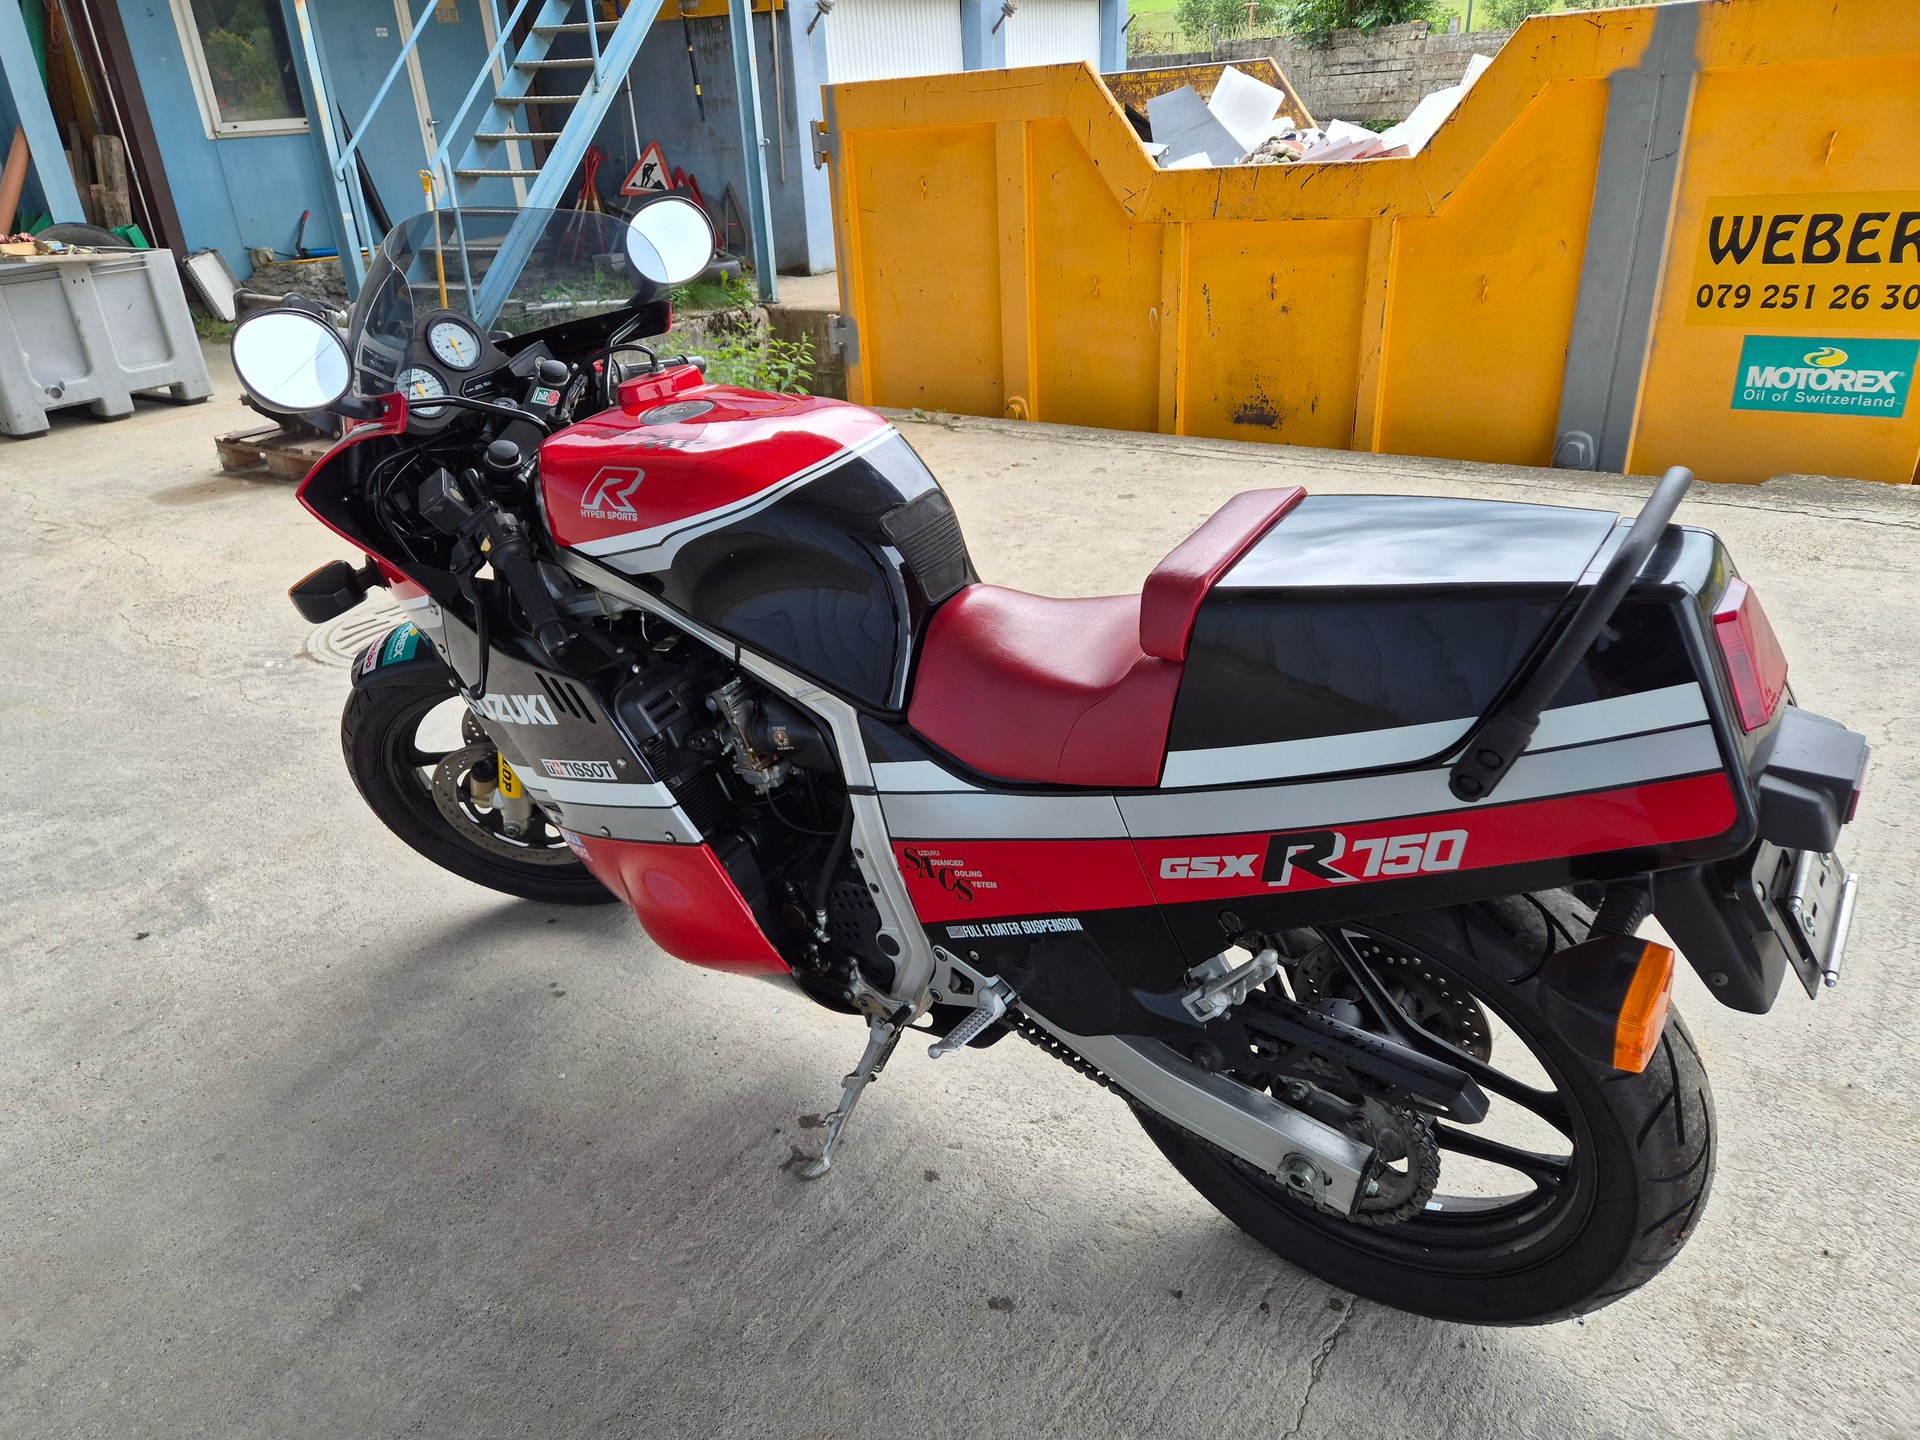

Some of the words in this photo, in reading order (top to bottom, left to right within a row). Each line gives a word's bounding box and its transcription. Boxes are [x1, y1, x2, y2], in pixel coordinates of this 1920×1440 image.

[1709, 211, 1920, 266] WEBER
[1696, 284, 1751, 309] 079
[1760, 284, 1816, 309] 251
[1829, 284, 1871, 309] 26
[1880, 284, 1920, 310] 30
[1746, 366, 1898, 394] MOTOREX
[1744, 389, 1765, 401] Oil
[1772, 391, 1788, 402] of
[1795, 392, 1895, 407] Switzerland
[581, 466, 646, 512] R
[581, 509, 605, 519] HYPER
[607, 511, 638, 521] SPORTS
[560, 761, 611, 778] TISSOT
[1159, 854, 1259, 879] GSX
[1260, 829, 1361, 887] R
[1352, 829, 1469, 877] 750
[962, 925, 985, 938] FULL
[982, 922, 1022, 936] FLOATER
[1020, 918, 1083, 934] SUSPENSION
